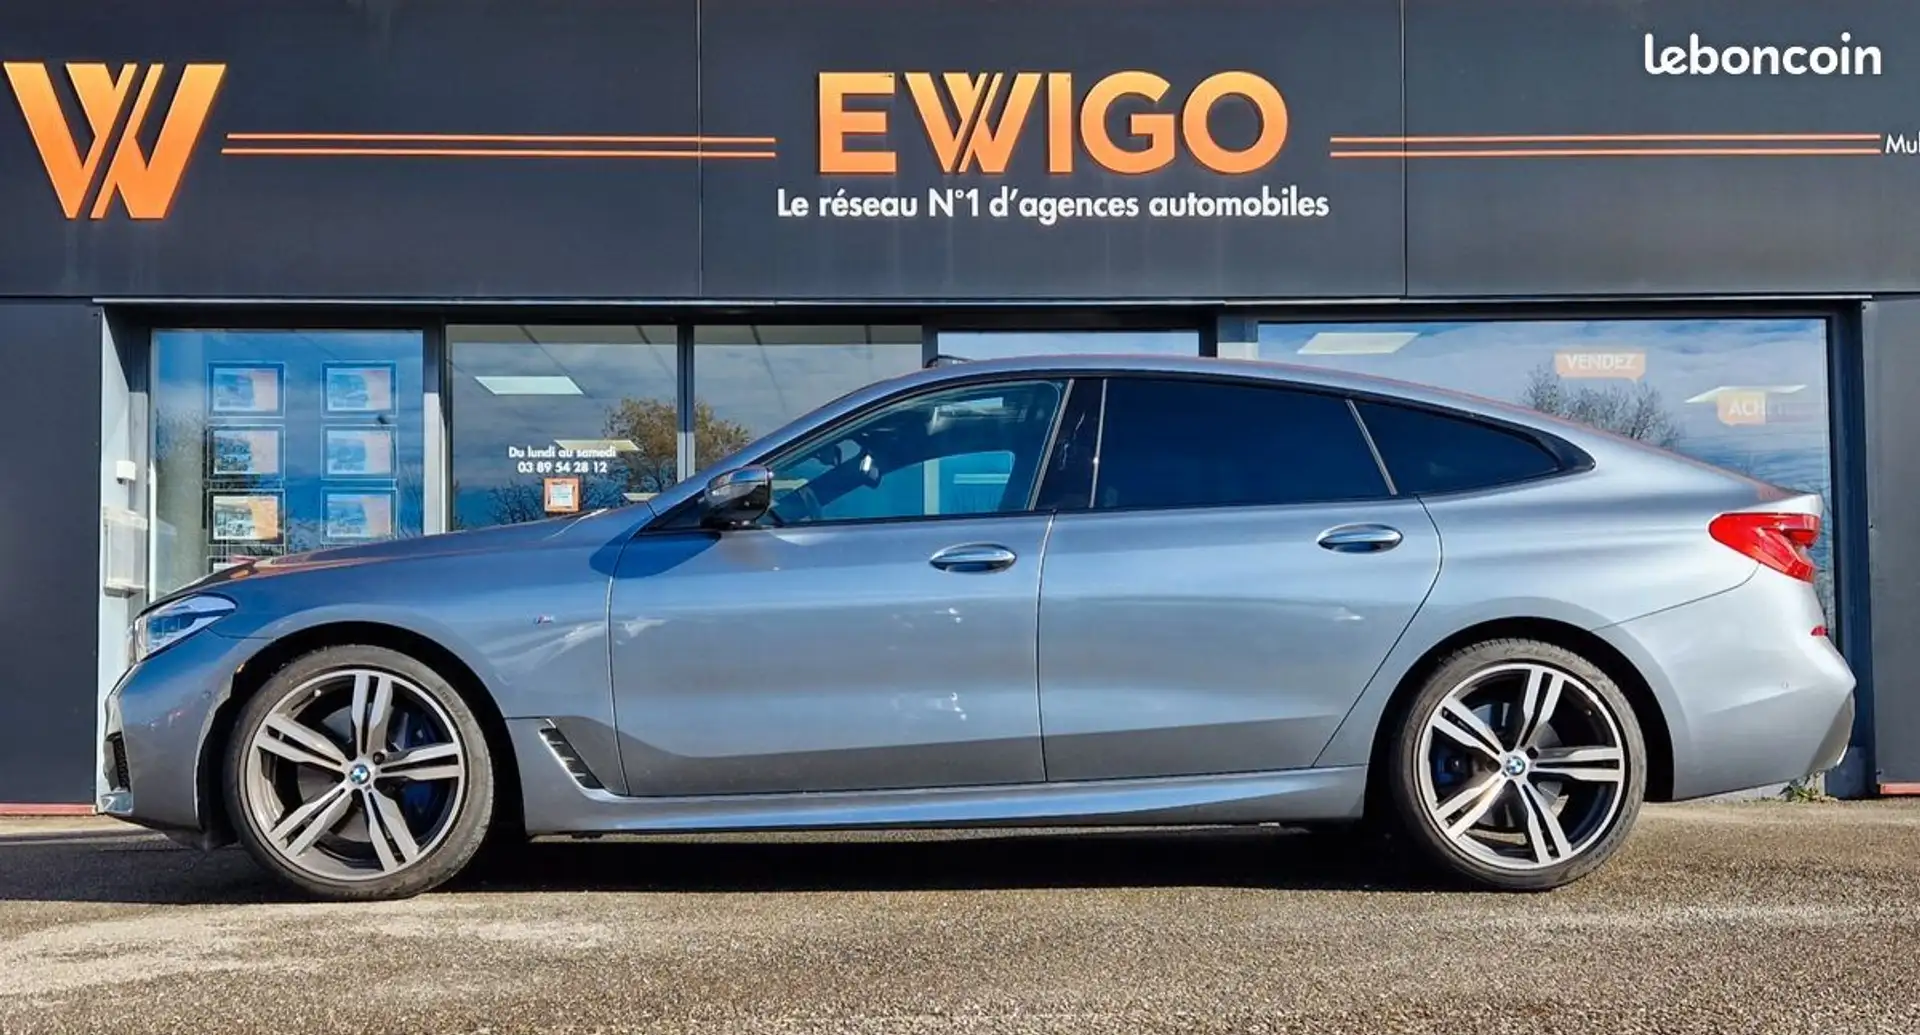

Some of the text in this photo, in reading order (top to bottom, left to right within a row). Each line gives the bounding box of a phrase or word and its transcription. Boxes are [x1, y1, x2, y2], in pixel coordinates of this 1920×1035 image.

[818, 71, 1289, 174] EWIGO
[777, 188, 808, 217] Le
[819, 187, 918, 217] réseau
[989, 185, 1140, 226] d’agences
[1149, 185, 1330, 217] automobiles
[1563, 353, 1637, 370] VENDEZ
[508, 445, 616, 458] Du lundi au samedi
[518, 461, 608, 473] 03 89 54 28 12
